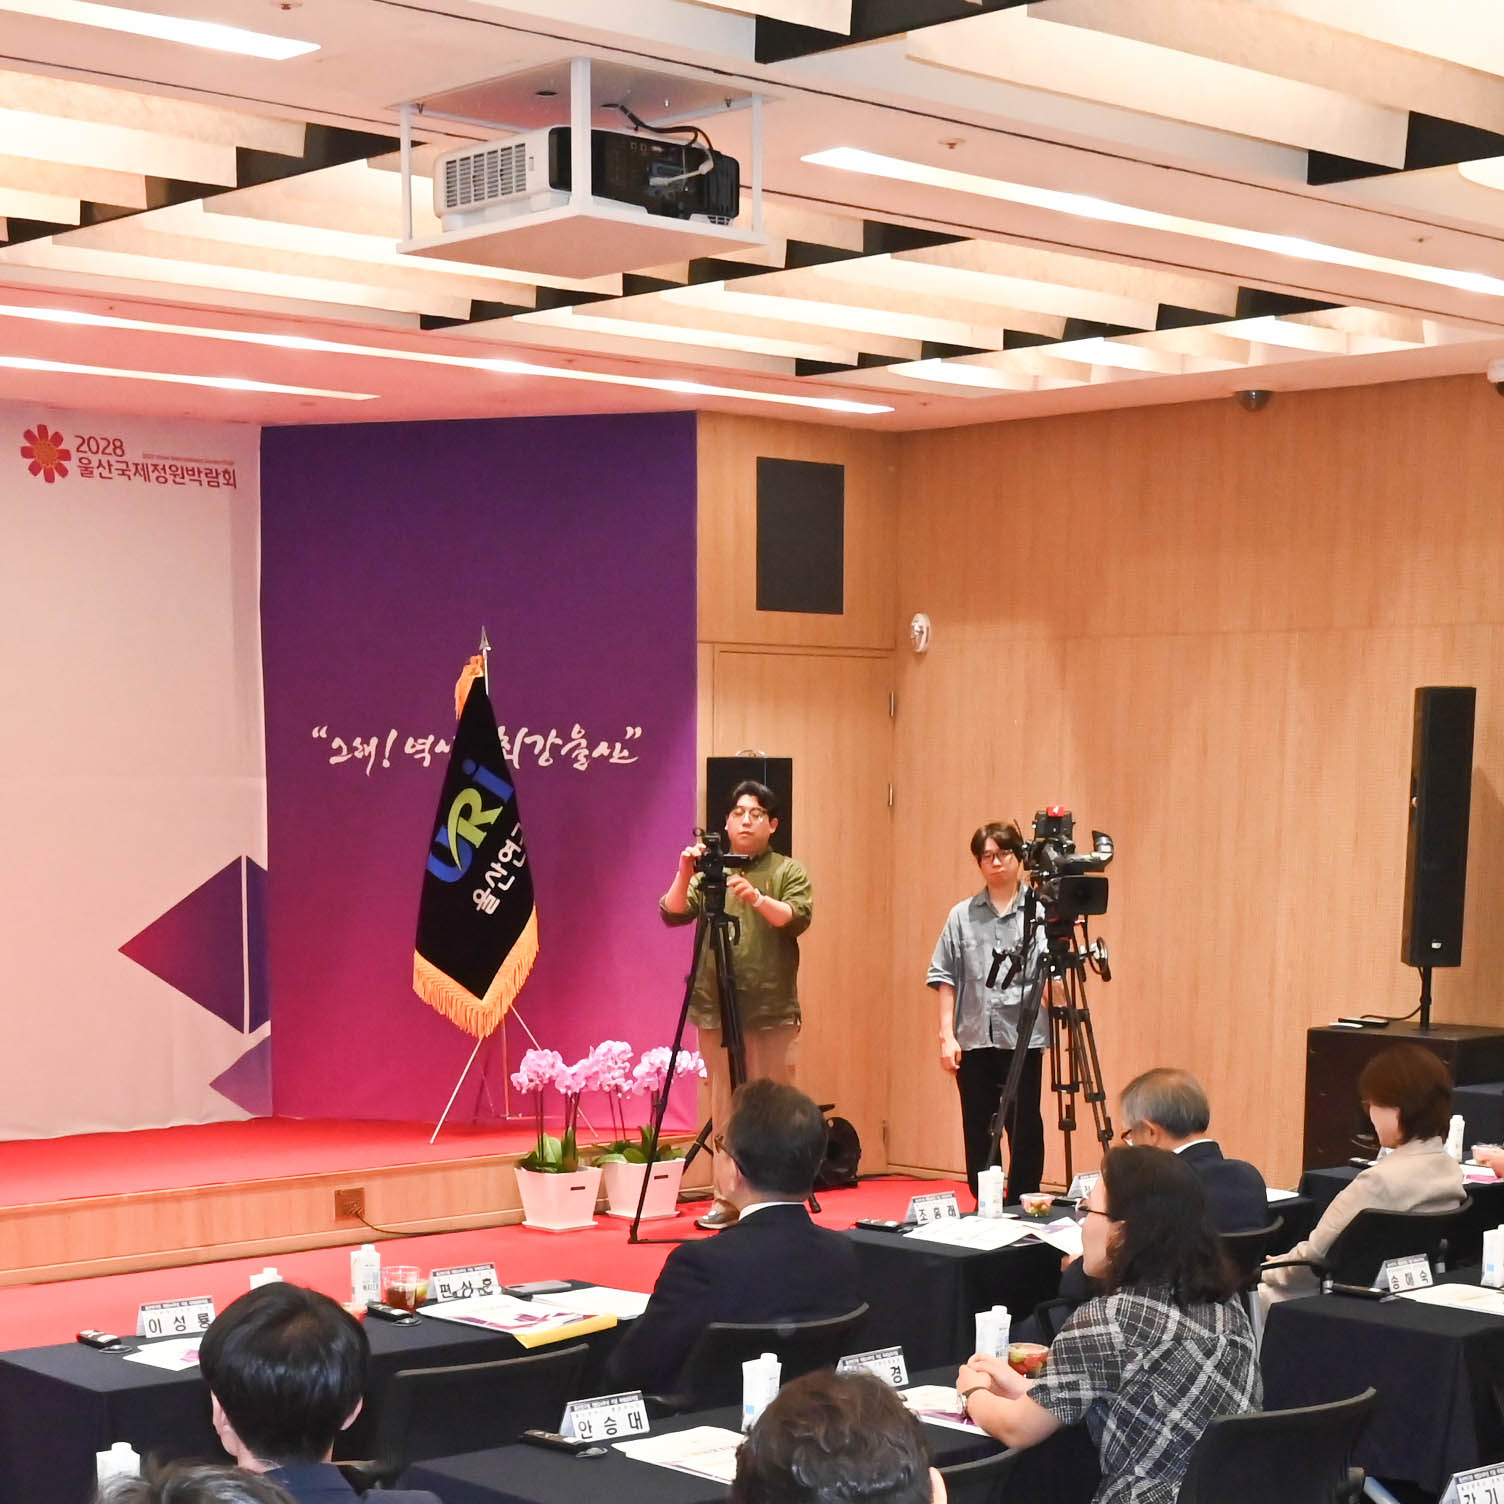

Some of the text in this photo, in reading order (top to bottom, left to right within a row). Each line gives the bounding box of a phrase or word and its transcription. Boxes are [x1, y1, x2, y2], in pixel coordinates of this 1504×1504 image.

[74, 435, 125, 457] 2028
[77, 457, 237, 489] 울산국제정원박람회
[578, 1410, 643, 1440] 안승대
